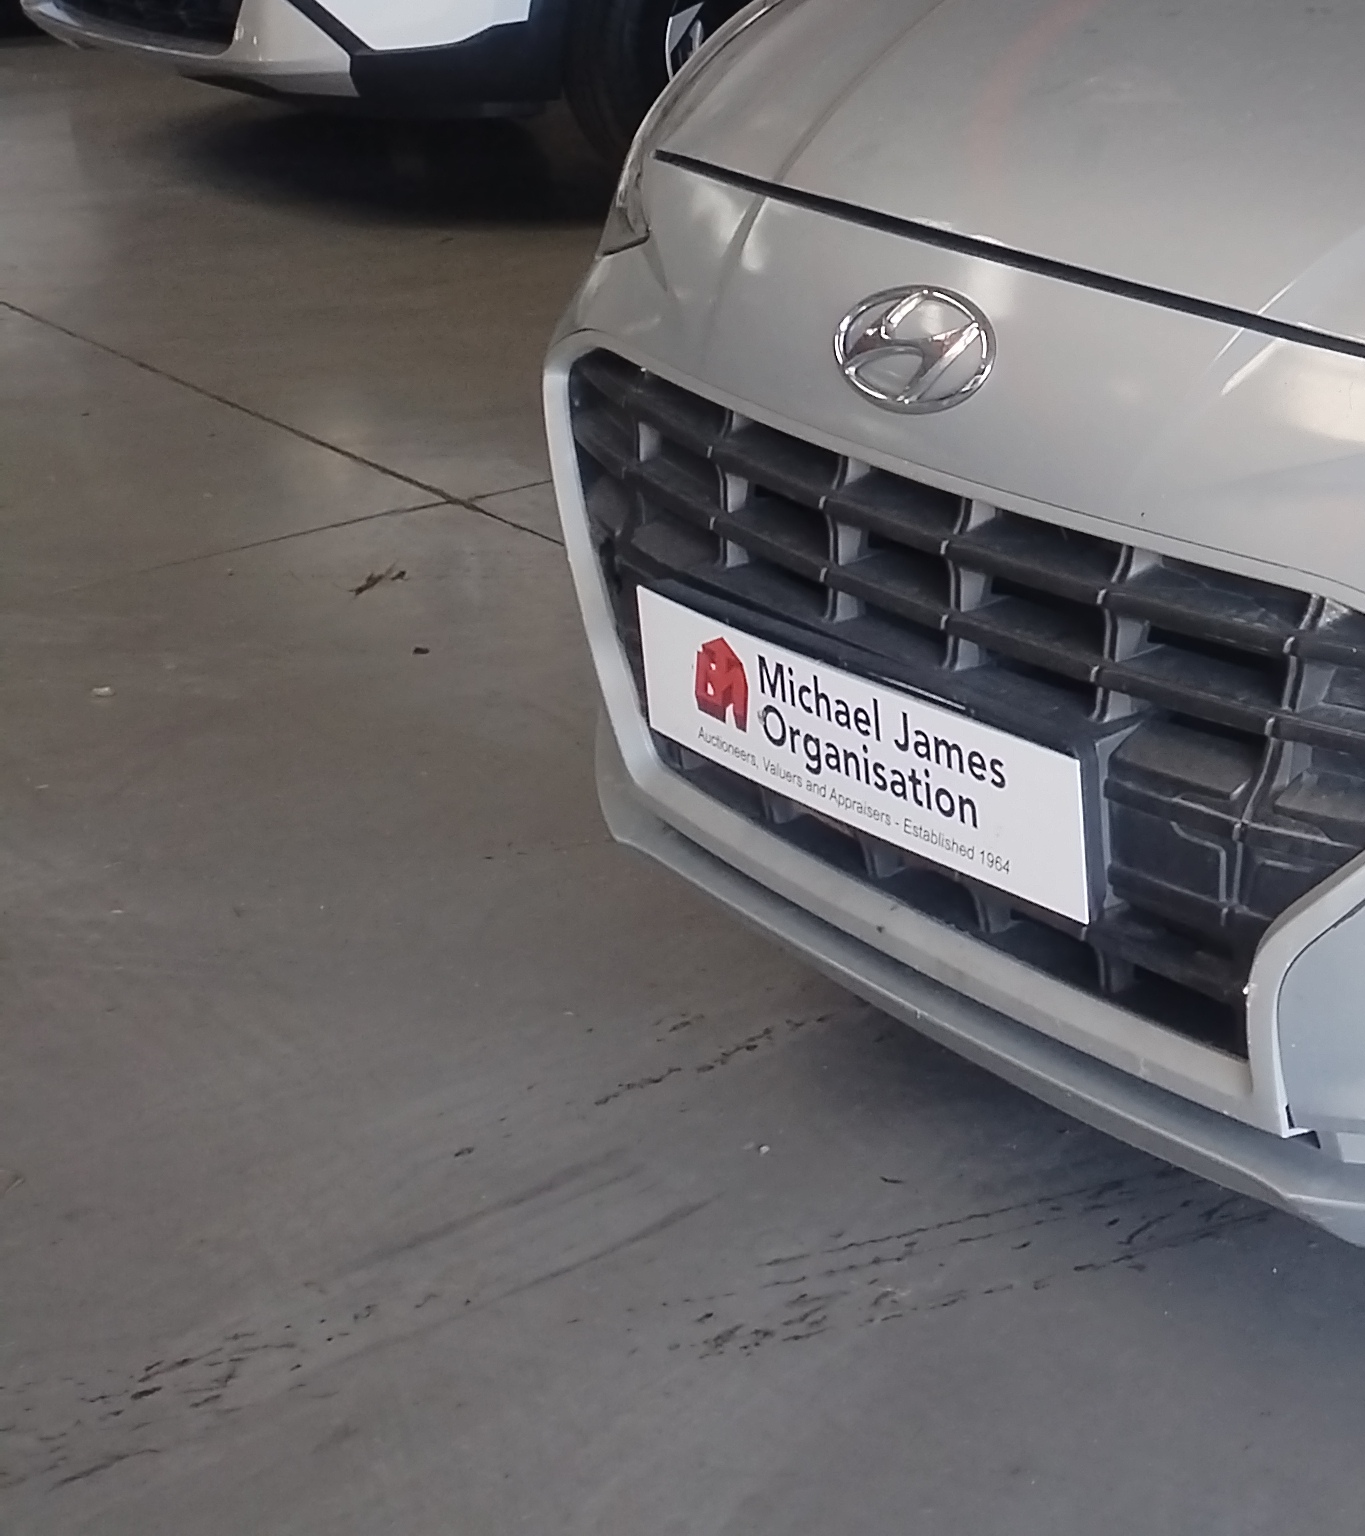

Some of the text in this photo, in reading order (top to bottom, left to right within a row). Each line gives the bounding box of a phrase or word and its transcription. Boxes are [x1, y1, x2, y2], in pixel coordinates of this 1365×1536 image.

[757, 654, 1007, 789] Michael James
[762, 704, 979, 829] Organisation
[697, 726, 759, 769] Auctioneers,
[762, 756, 803, 788] Valuers
[806, 779, 828, 799] and
[829, 787, 892, 827] Appraisers
[903, 818, 975, 860] Established
[979, 850, 1011, 875] 1964
